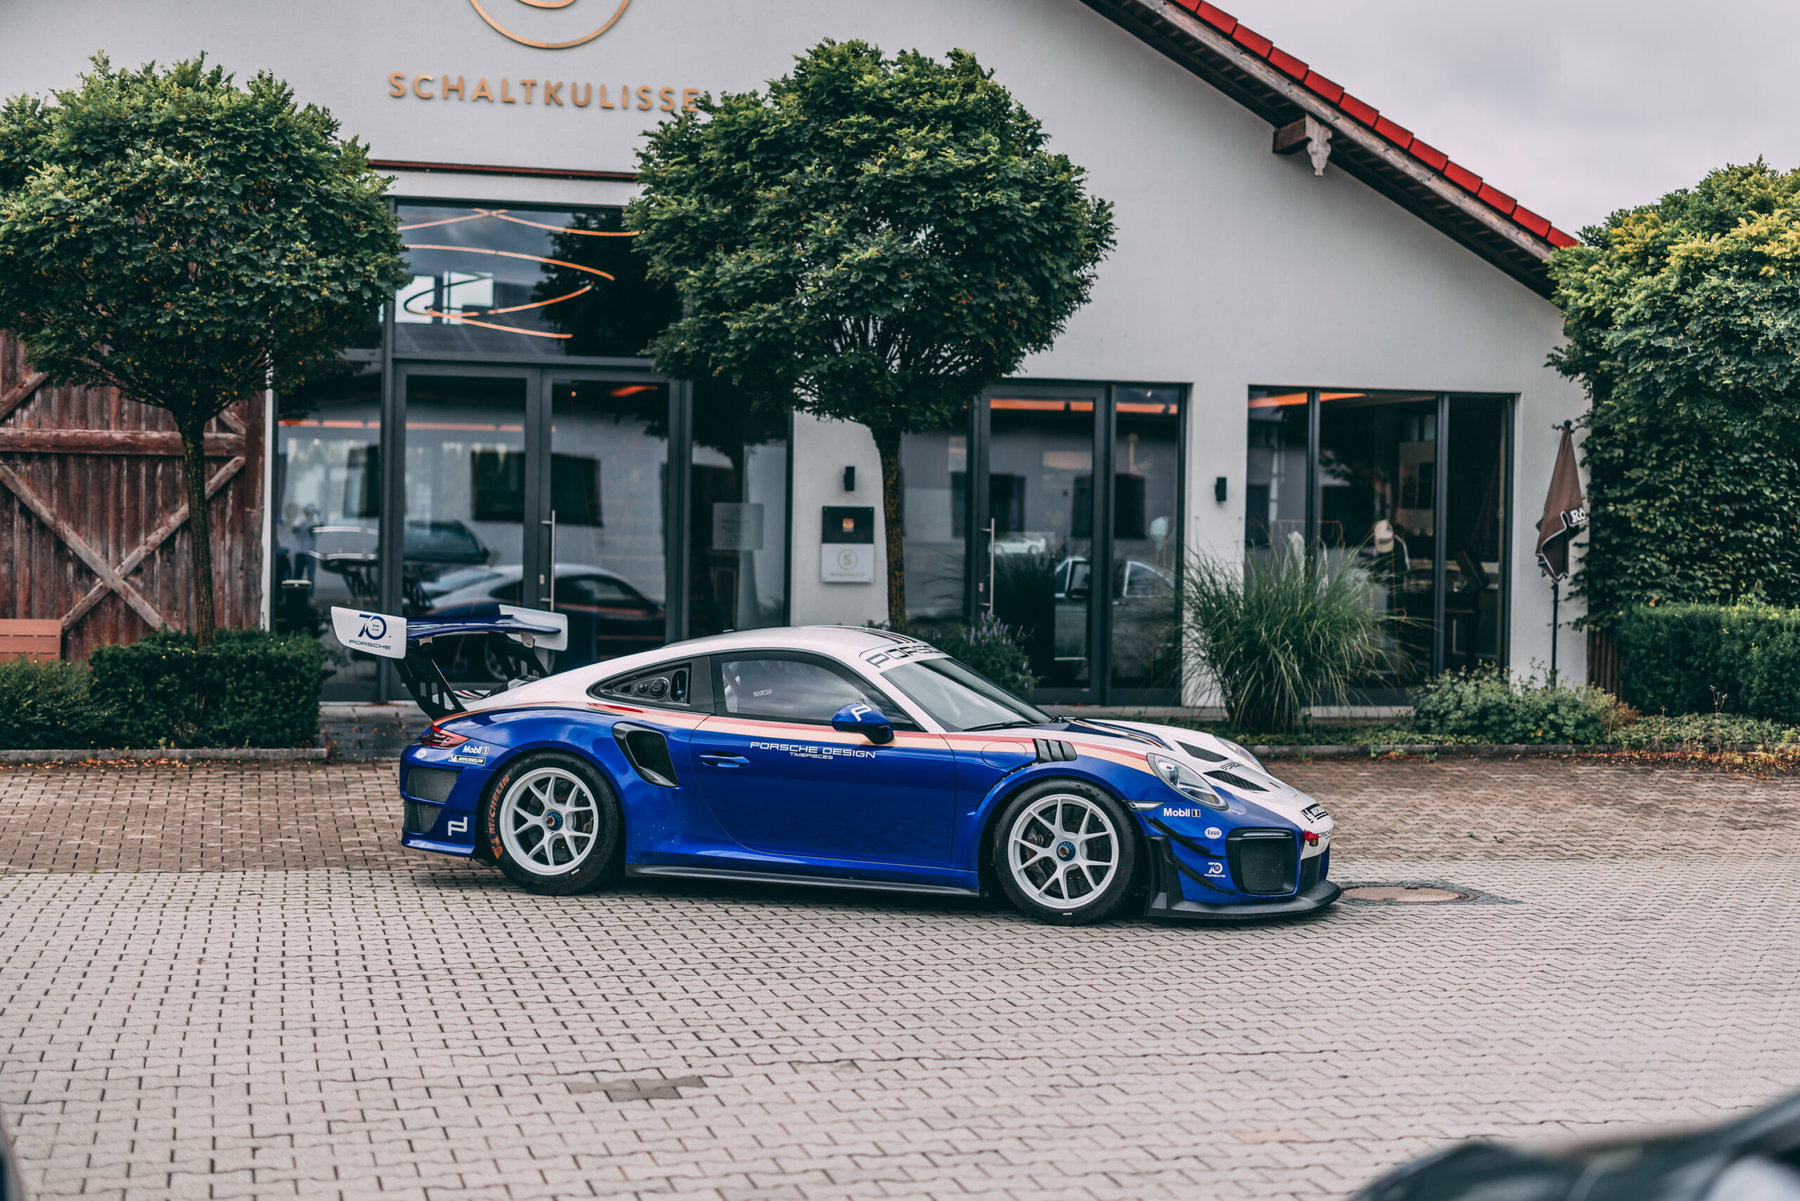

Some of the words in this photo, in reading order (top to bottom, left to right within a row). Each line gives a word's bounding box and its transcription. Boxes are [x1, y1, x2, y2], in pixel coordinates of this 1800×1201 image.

[388, 72, 700, 112] SCHALTKULISSE
[462, 745, 482, 755] Mobil
[750, 741, 819, 754] PORSCHE
[822, 747, 877, 759] DESIGN
[789, 752, 834, 760] TIMEPIECES
[488, 774, 510, 835] MICHELIN
[1163, 807, 1190, 818] Mobil
